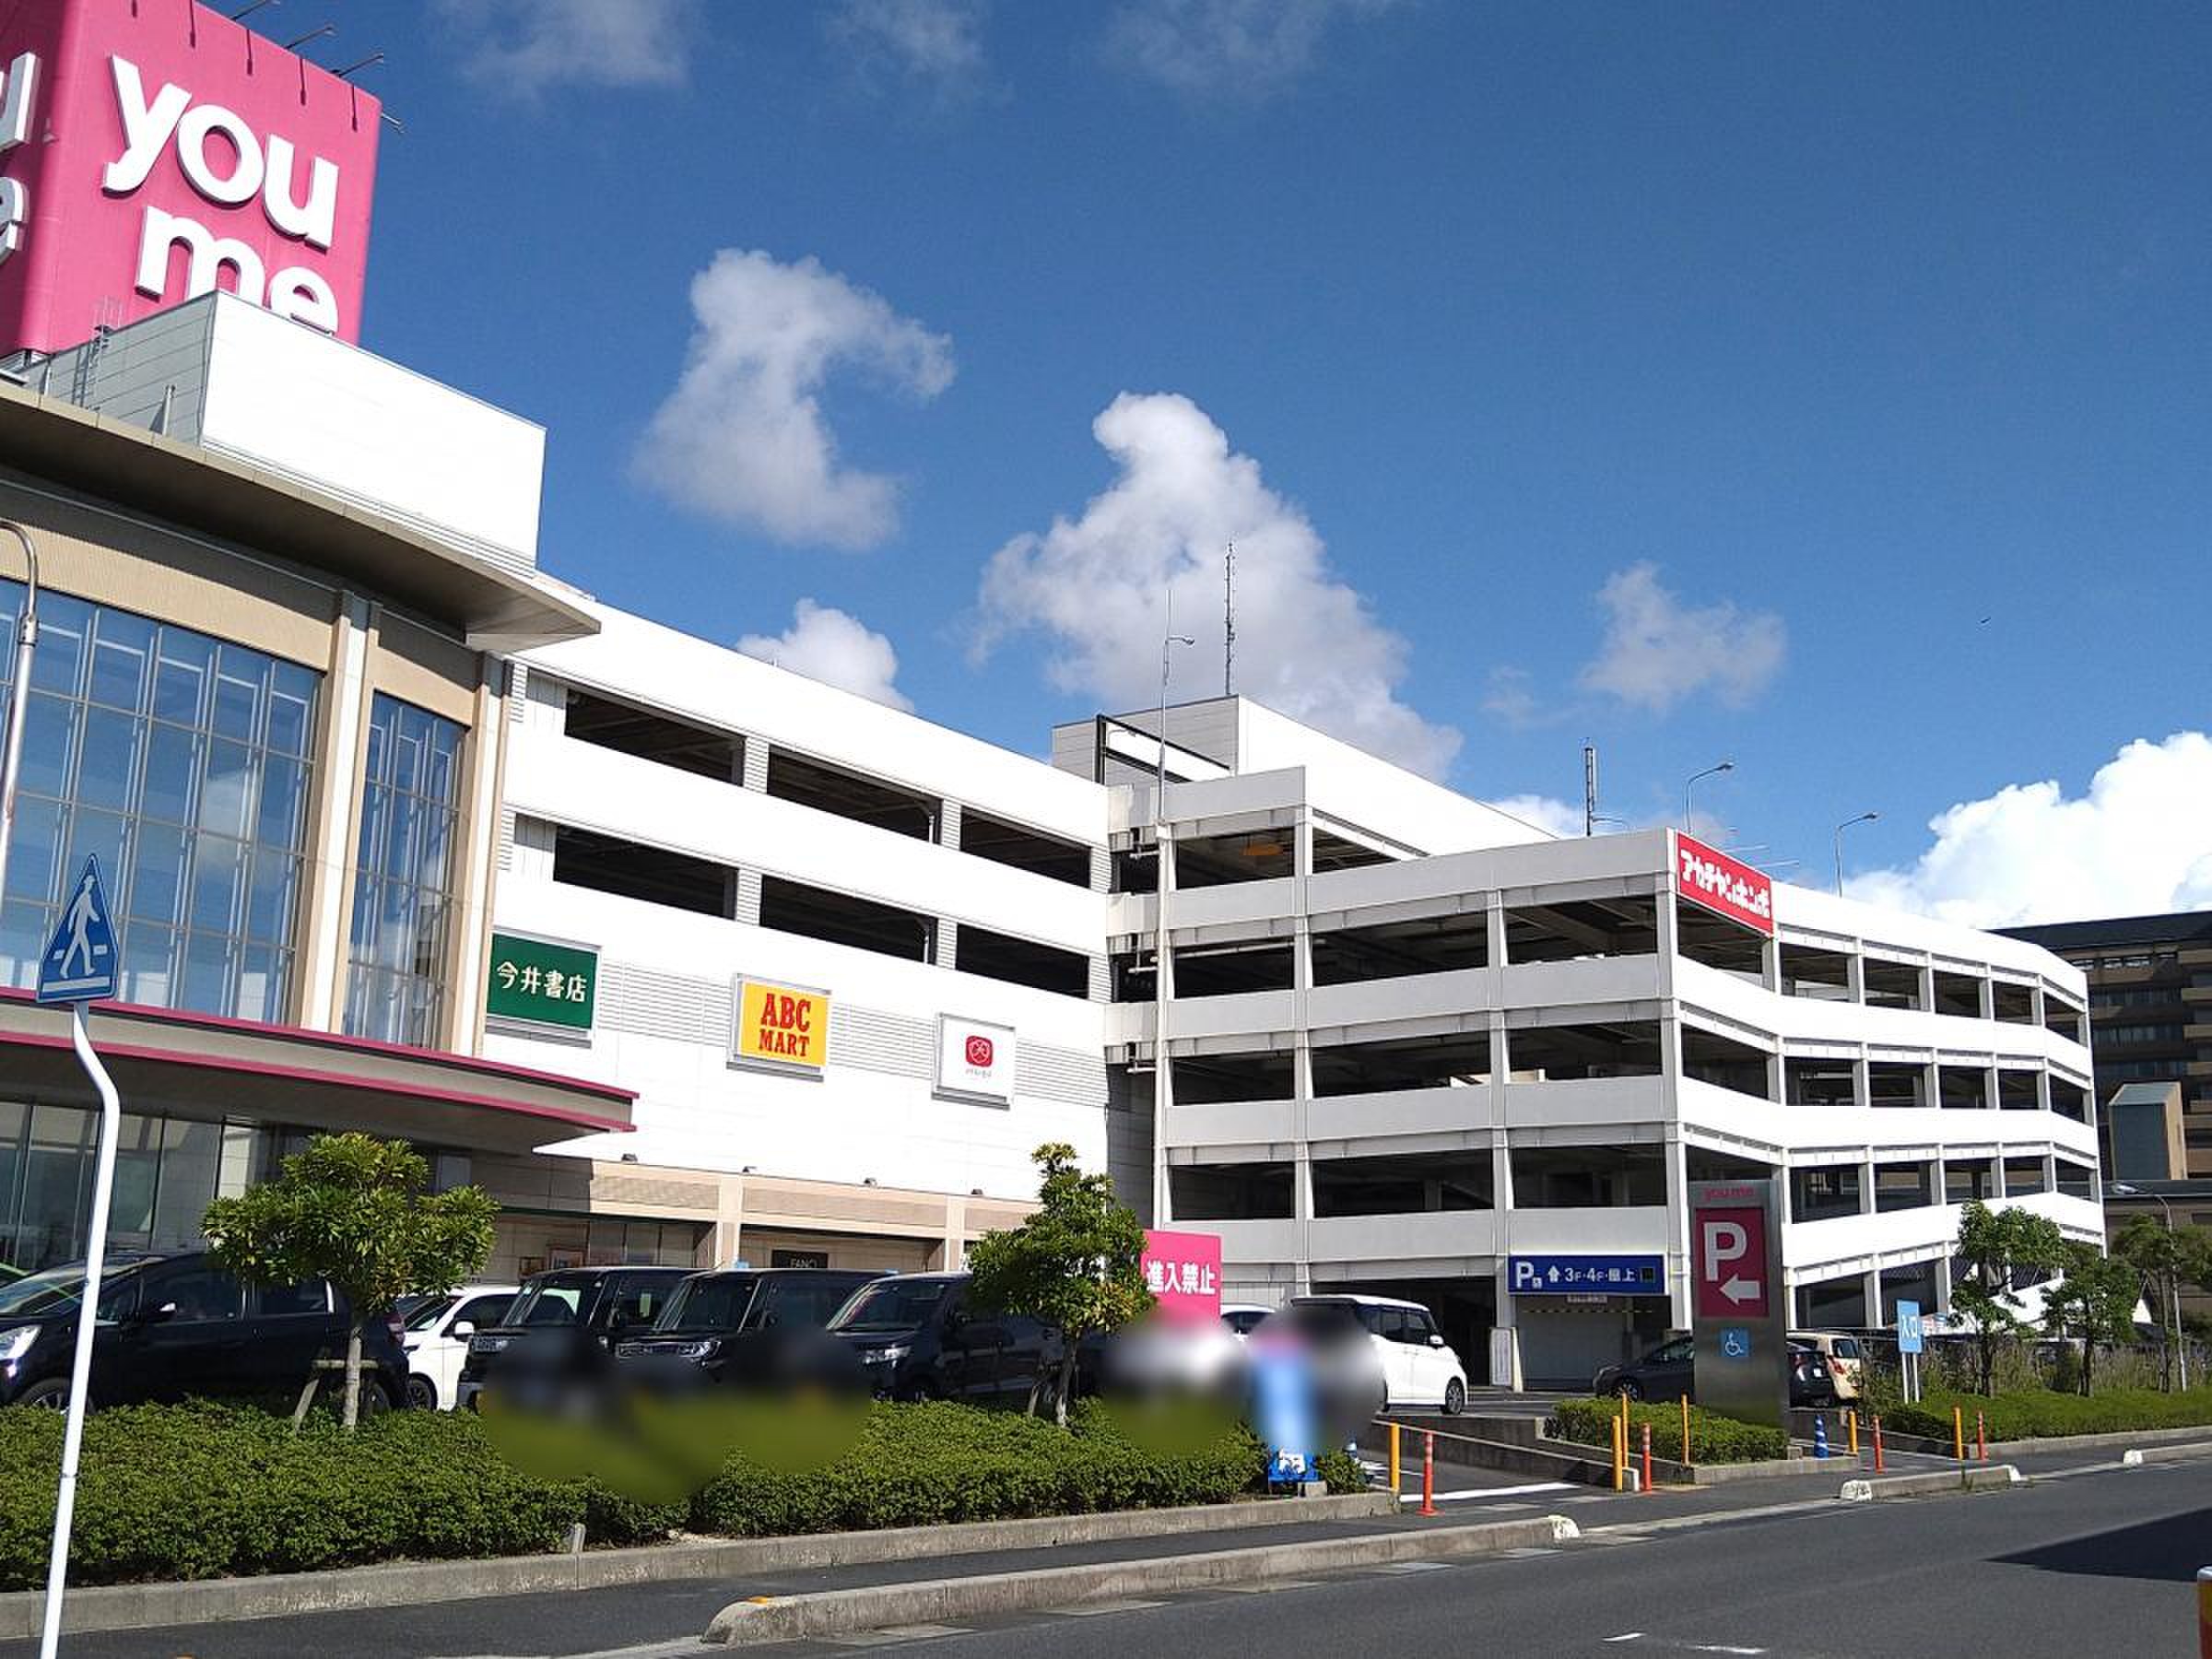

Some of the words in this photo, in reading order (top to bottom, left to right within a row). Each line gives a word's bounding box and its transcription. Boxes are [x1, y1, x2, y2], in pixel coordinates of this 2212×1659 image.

[102, 53, 340, 253] you
[135, 206, 339, 336] me
[497, 960, 587, 1003] 今井書店
[760, 993, 812, 1033] ABC
[759, 1028, 810, 1057] MART
[1703, 1221, 1747, 1282] P
[1146, 1259, 1217, 1295] 進入禁止
[1514, 1260, 1535, 1289] P
